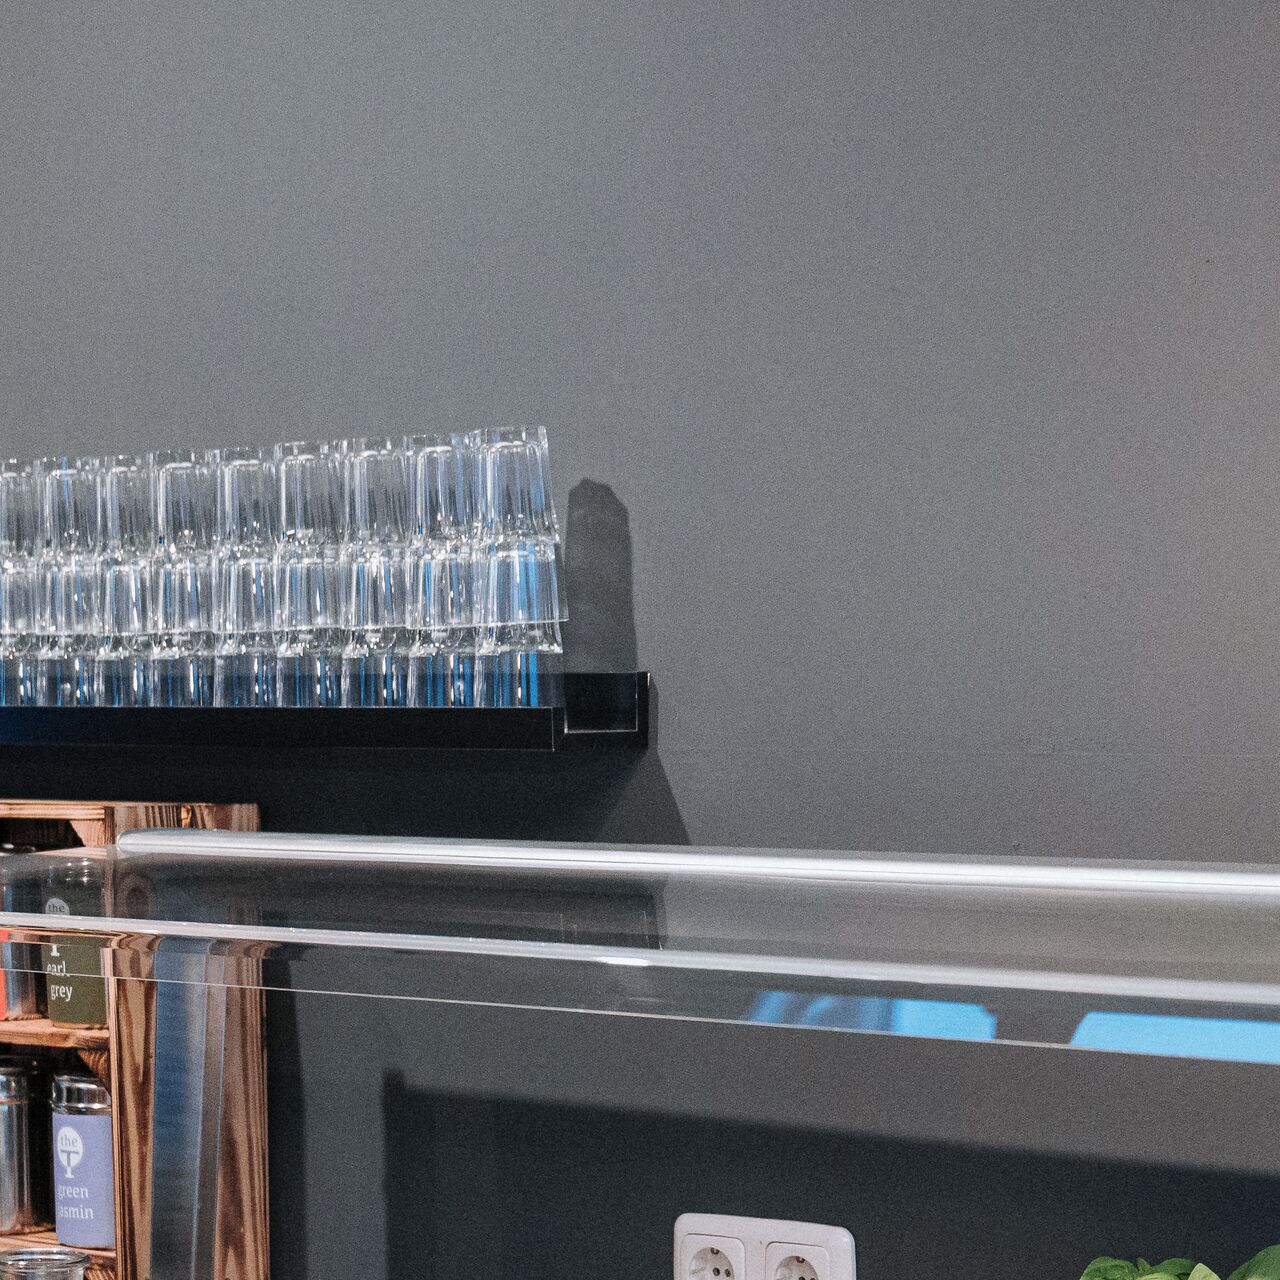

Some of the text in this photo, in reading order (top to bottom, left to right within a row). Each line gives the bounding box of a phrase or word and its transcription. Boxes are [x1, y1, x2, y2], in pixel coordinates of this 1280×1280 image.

[46, 961, 67, 976] earl
[50, 985, 73, 1002] grey
[60, 1134, 78, 1147] the
[58, 1184, 89, 1200] green
